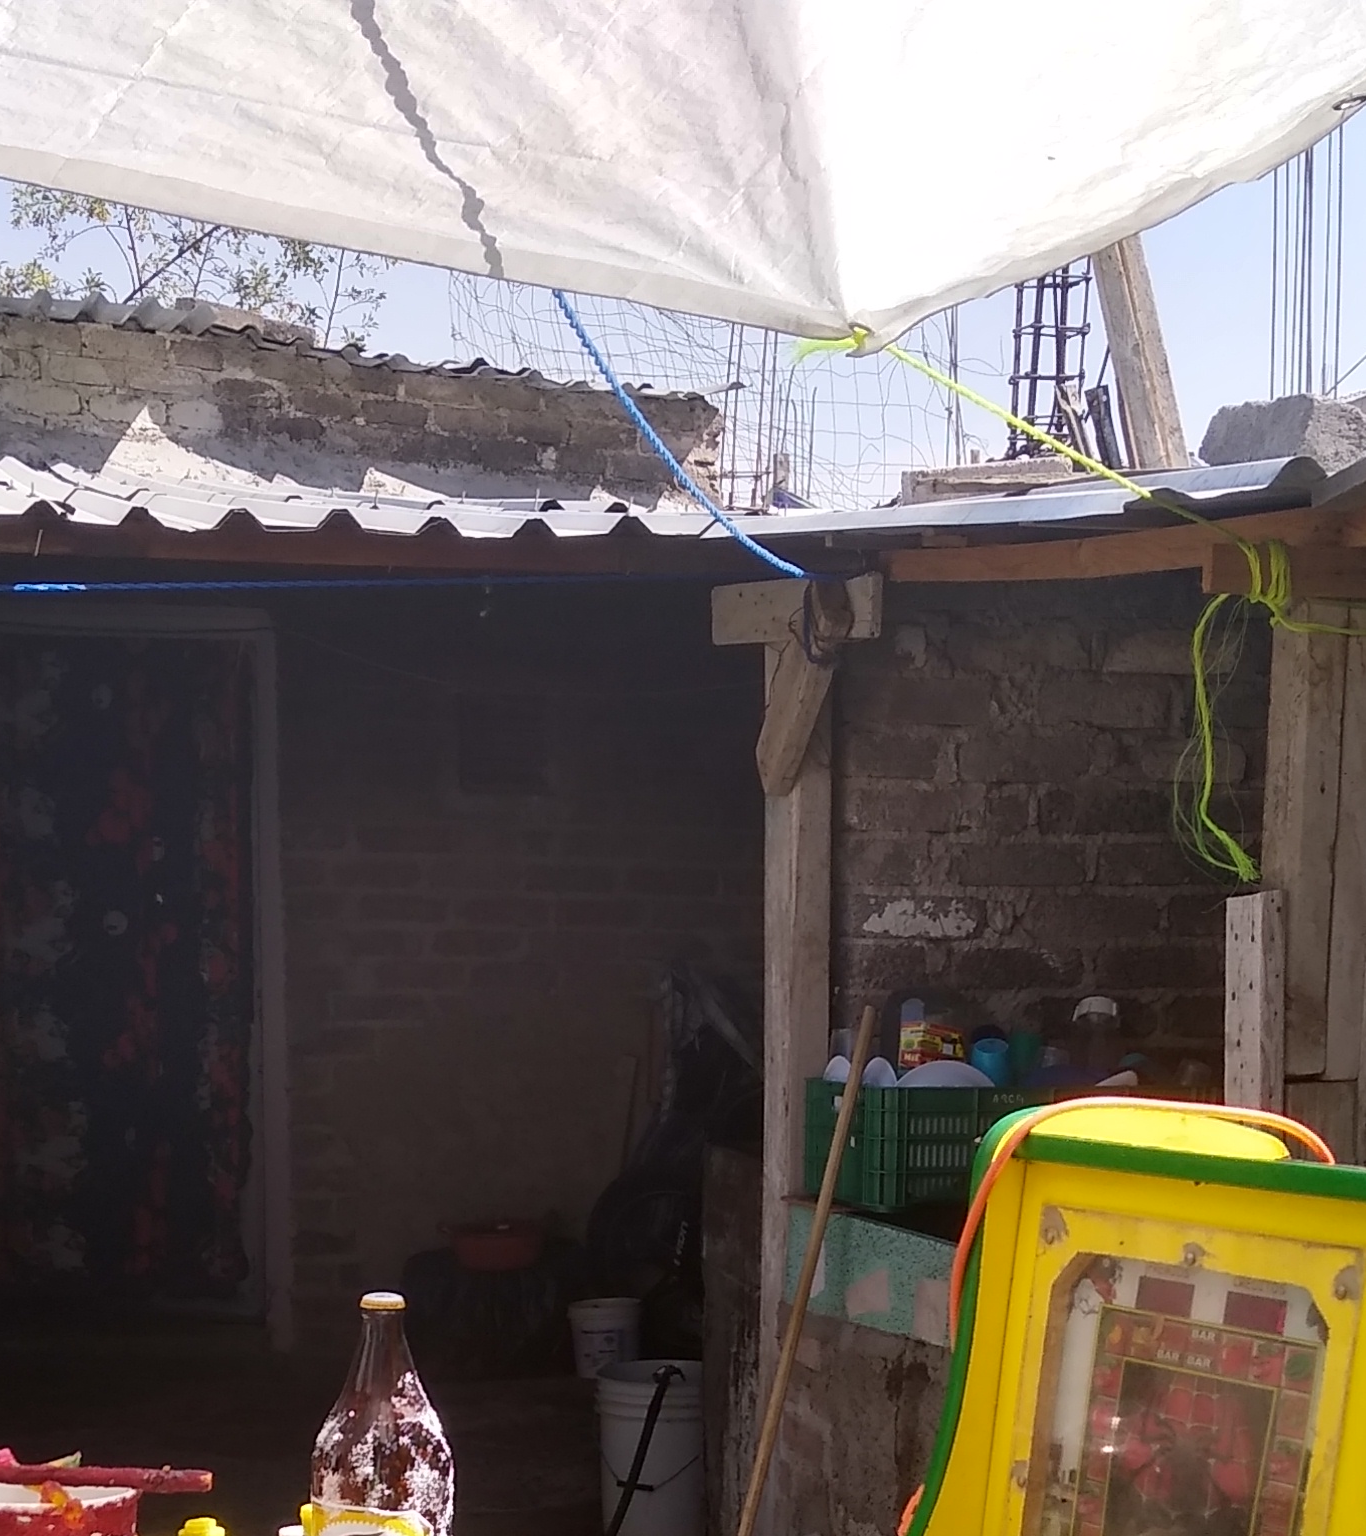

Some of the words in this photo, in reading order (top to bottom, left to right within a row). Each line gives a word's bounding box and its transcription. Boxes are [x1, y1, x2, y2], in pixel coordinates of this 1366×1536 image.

[1192, 1328, 1216, 1342] BAR
[1156, 1349, 1181, 1362] BAR
[1186, 1355, 1212, 1369] BAR
